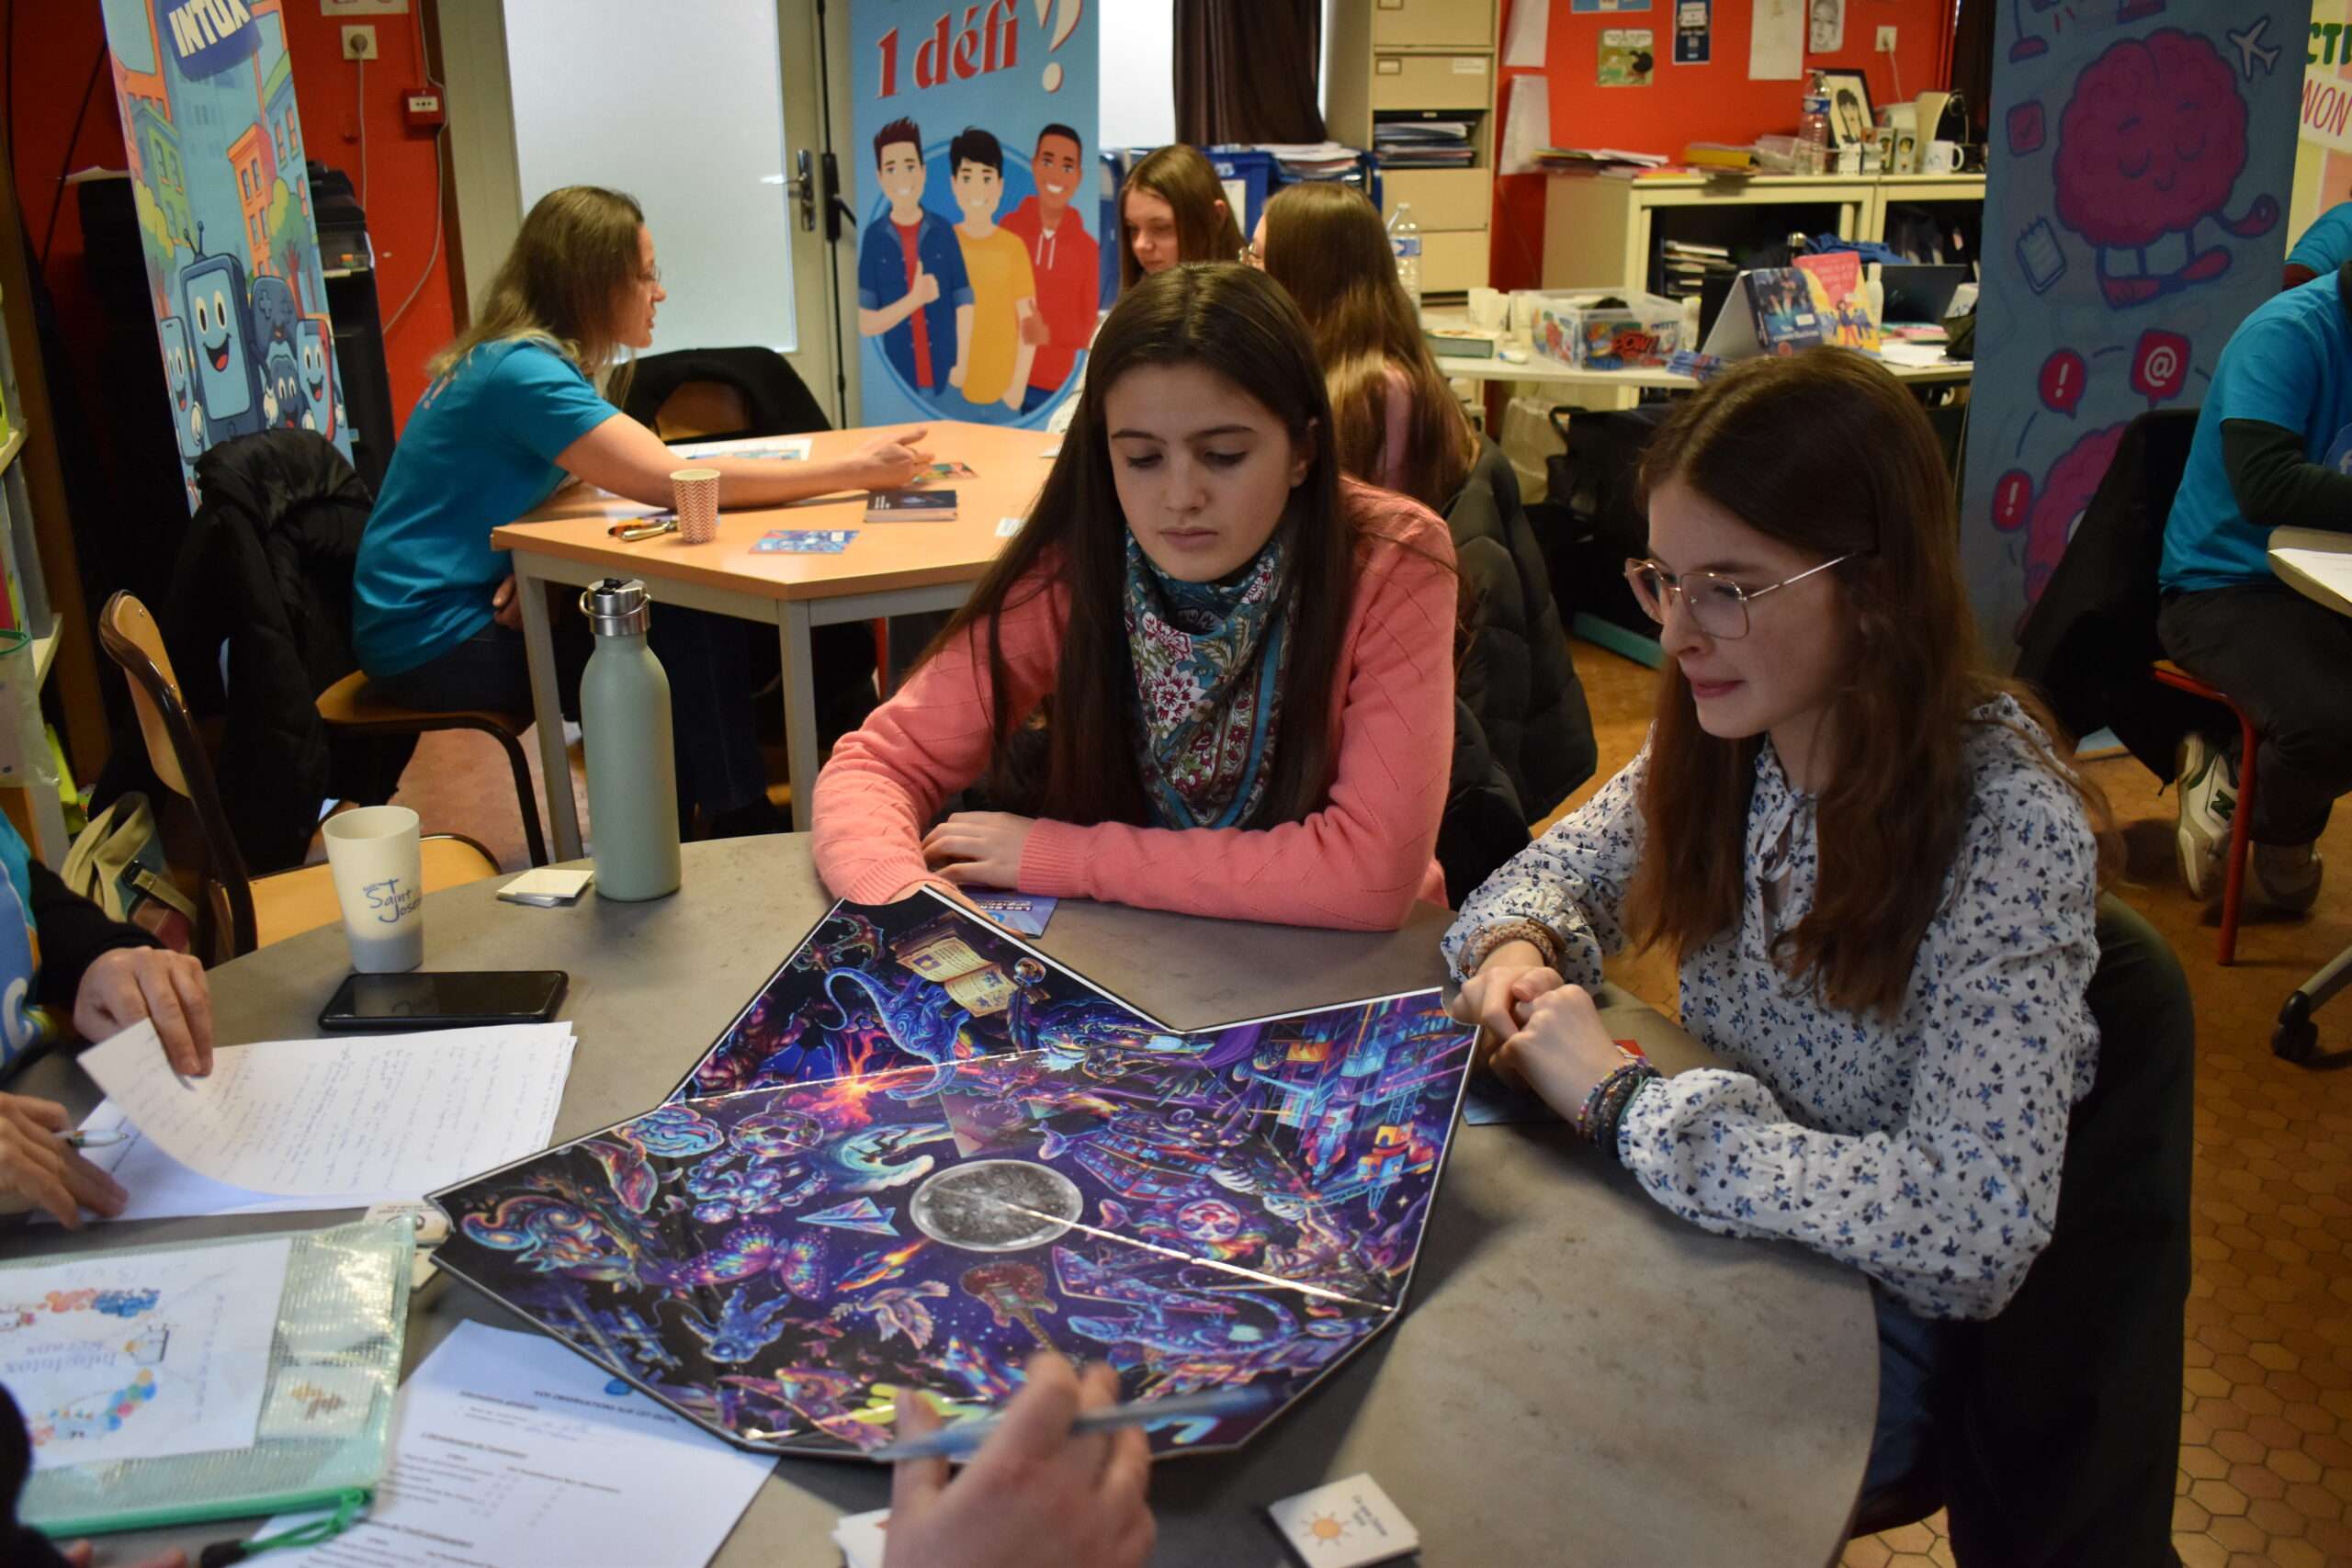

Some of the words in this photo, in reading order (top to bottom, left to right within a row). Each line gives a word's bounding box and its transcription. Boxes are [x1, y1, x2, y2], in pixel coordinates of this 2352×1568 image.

[876, 26, 899, 99] 1
[912, 0, 1019, 89] défi
[366, 887, 412, 908] Saint
